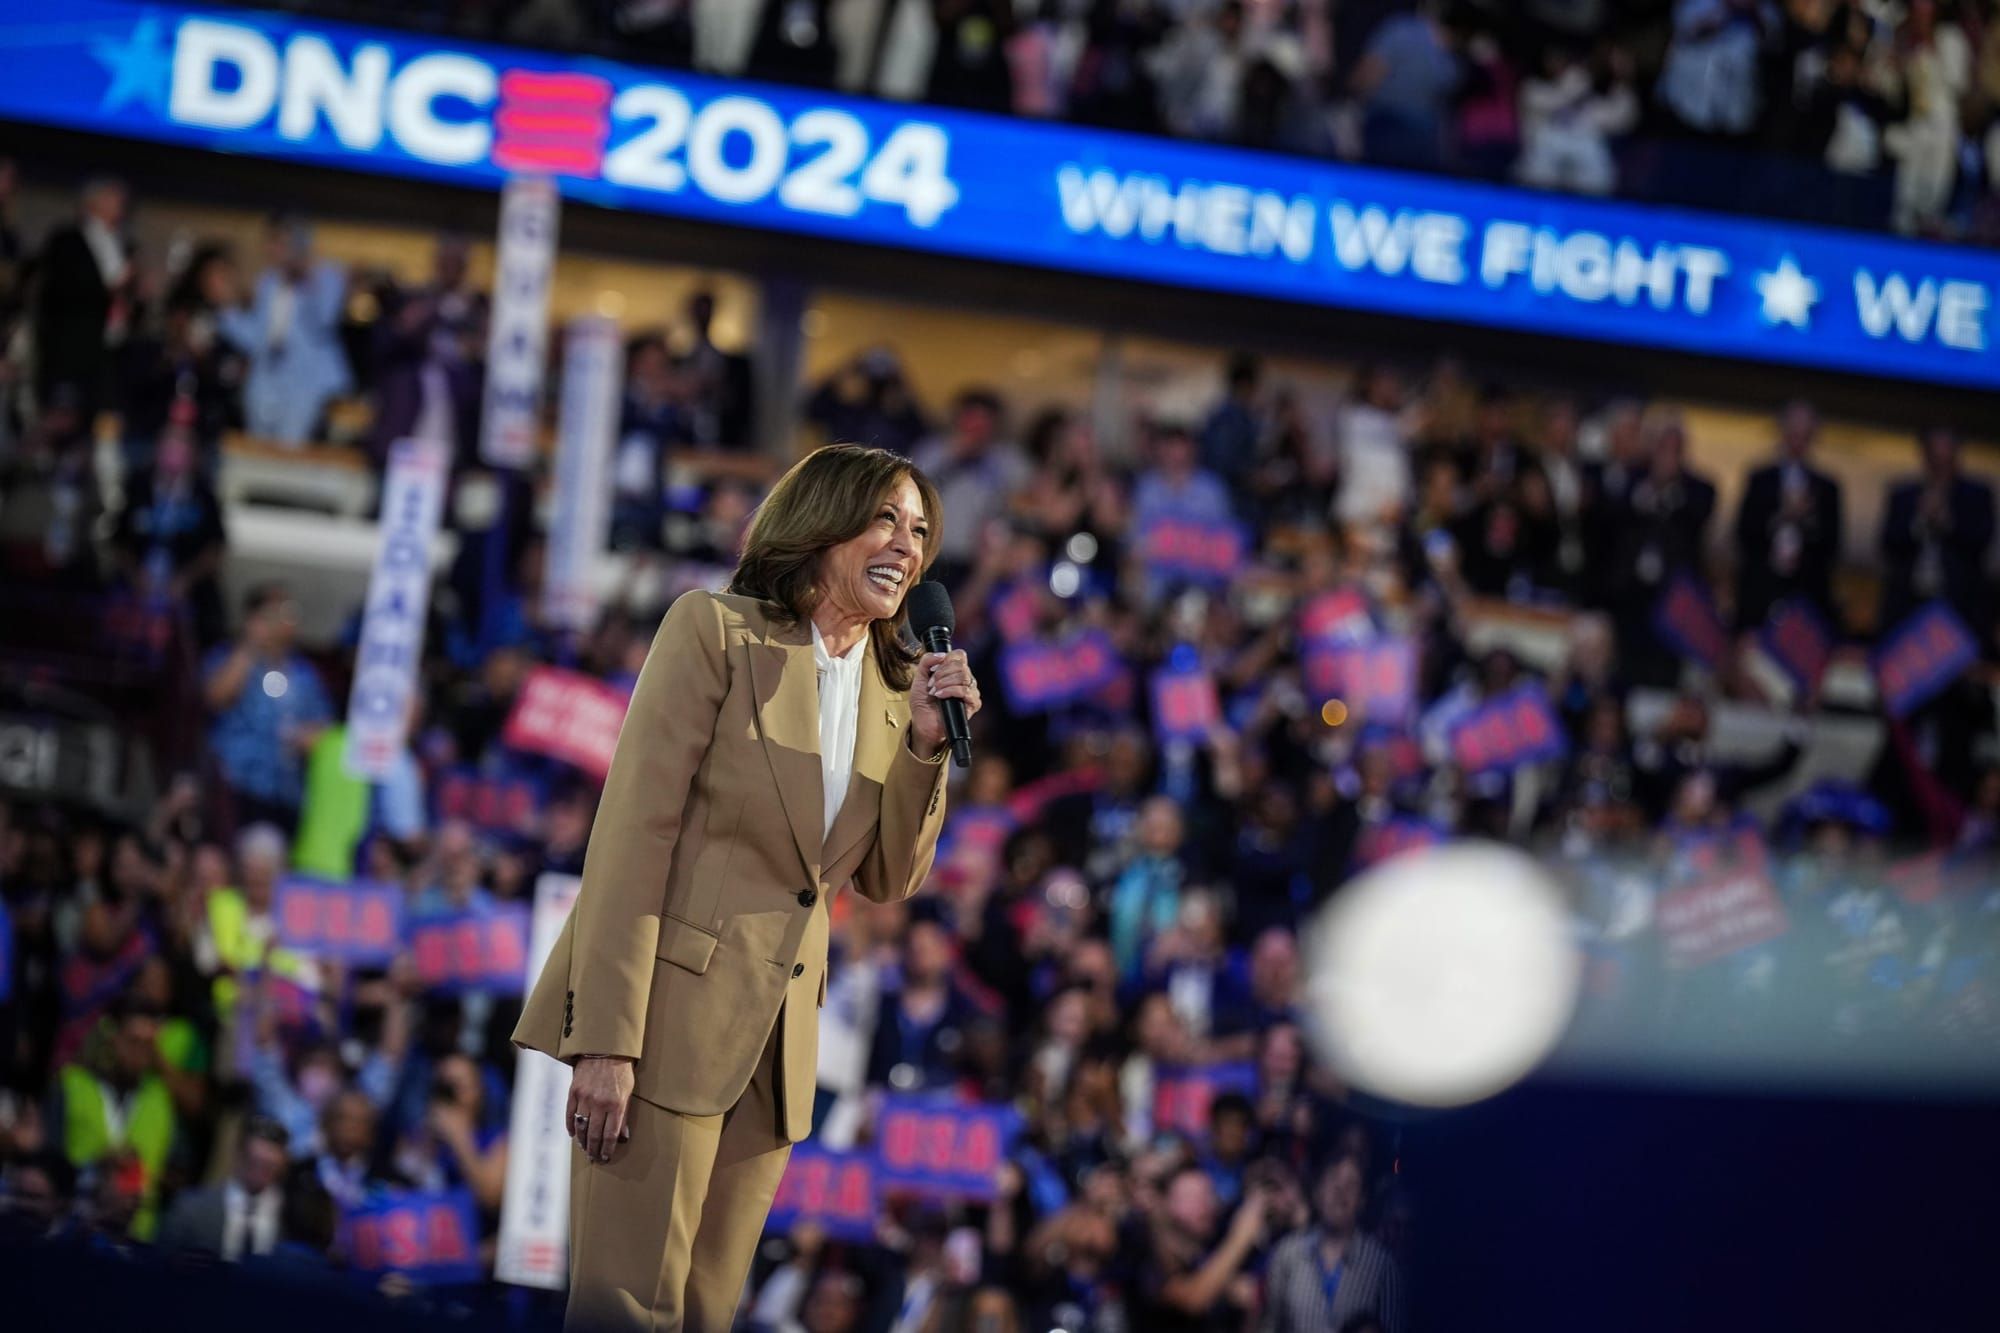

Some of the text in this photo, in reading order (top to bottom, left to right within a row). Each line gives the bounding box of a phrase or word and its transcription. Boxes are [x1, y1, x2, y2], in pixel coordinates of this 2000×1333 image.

[172, 19, 960, 228] DNC 2024
[1056, 162, 1987, 351] WHEN WE FIGHT WE
[356, 485, 428, 718] IDAHO
[283, 892, 393, 944] USA
[416, 922, 525, 978] USA
[884, 1114, 998, 1173] USA
[355, 1208, 464, 1271] USA
